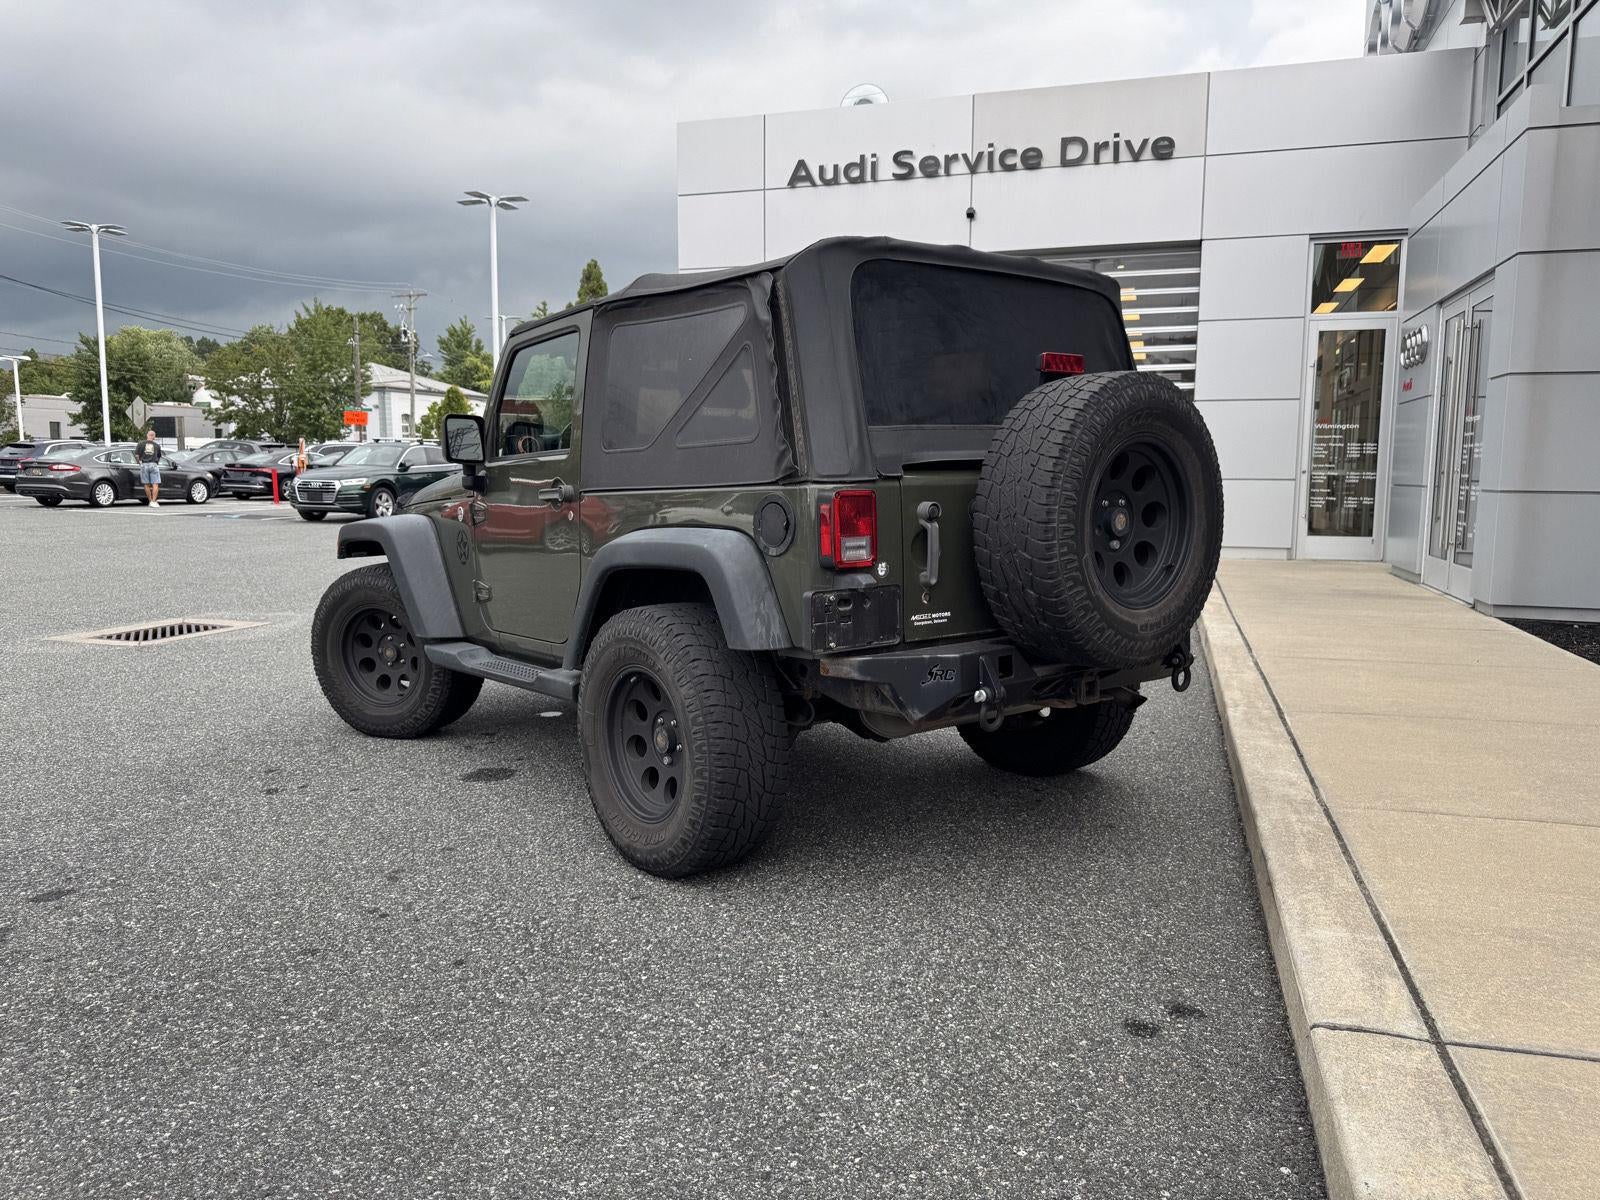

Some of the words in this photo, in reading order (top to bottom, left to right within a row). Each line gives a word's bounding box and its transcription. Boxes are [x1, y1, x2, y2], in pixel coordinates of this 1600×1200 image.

[786, 153, 877, 187] Audi
[892, 143, 1043, 180] Service
[1060, 133, 1175, 166] Drive
